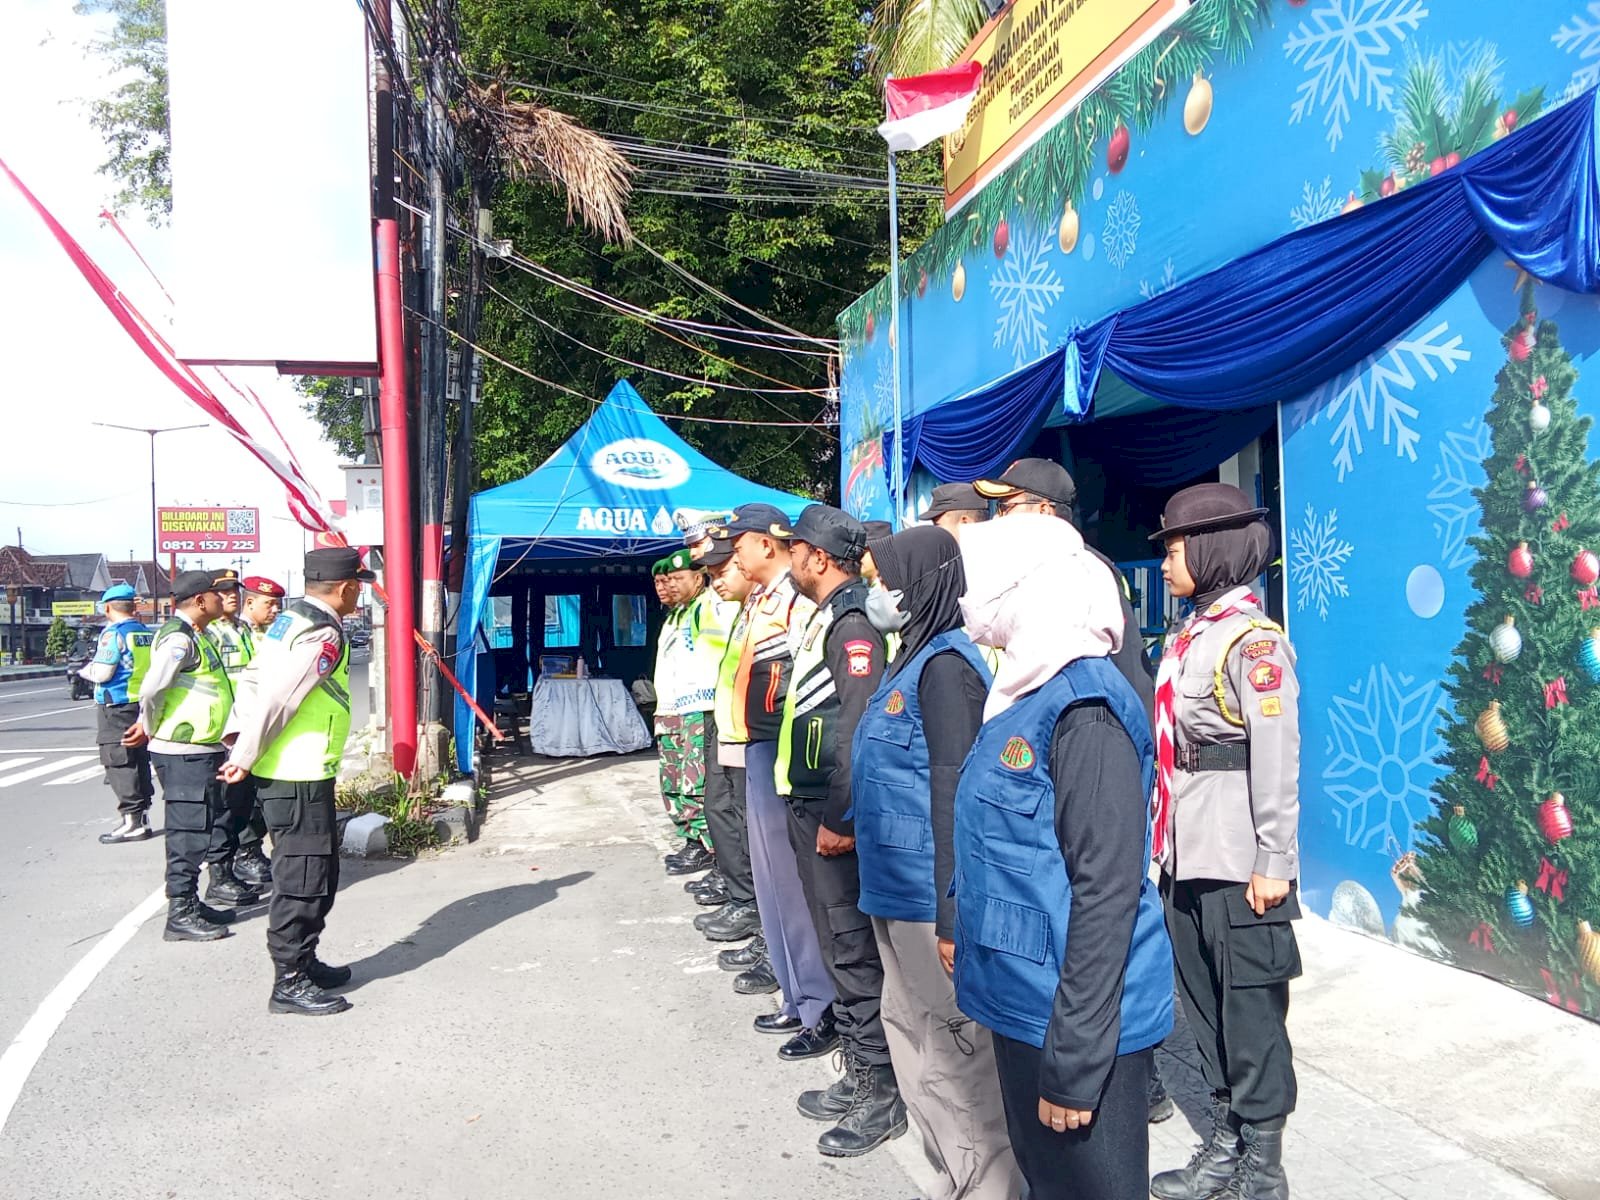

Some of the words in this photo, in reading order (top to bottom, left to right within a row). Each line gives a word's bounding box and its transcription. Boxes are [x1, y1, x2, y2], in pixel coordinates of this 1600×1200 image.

[983, 0, 1047, 88] PENGAMANAN
[997, 64, 1015, 95] NATAL
[1033, 27, 1048, 55] DAN
[1049, 0, 1075, 37] TAHUN
[1010, 37, 1059, 101] PRAMBANAN
[1009, 88, 1034, 125] POLRES
[1035, 57, 1064, 99] KLATEN
[605, 451, 672, 467] AQUA
[161, 511, 209, 521] BILLBOARD
[212, 511, 225, 521] INI
[161, 521, 225, 532] DISEWAKAN
[576, 507, 648, 534] AQUA
[162, 540, 195, 550] 0812
[199, 540, 228, 550] 1557
[232, 540, 255, 550] 225
